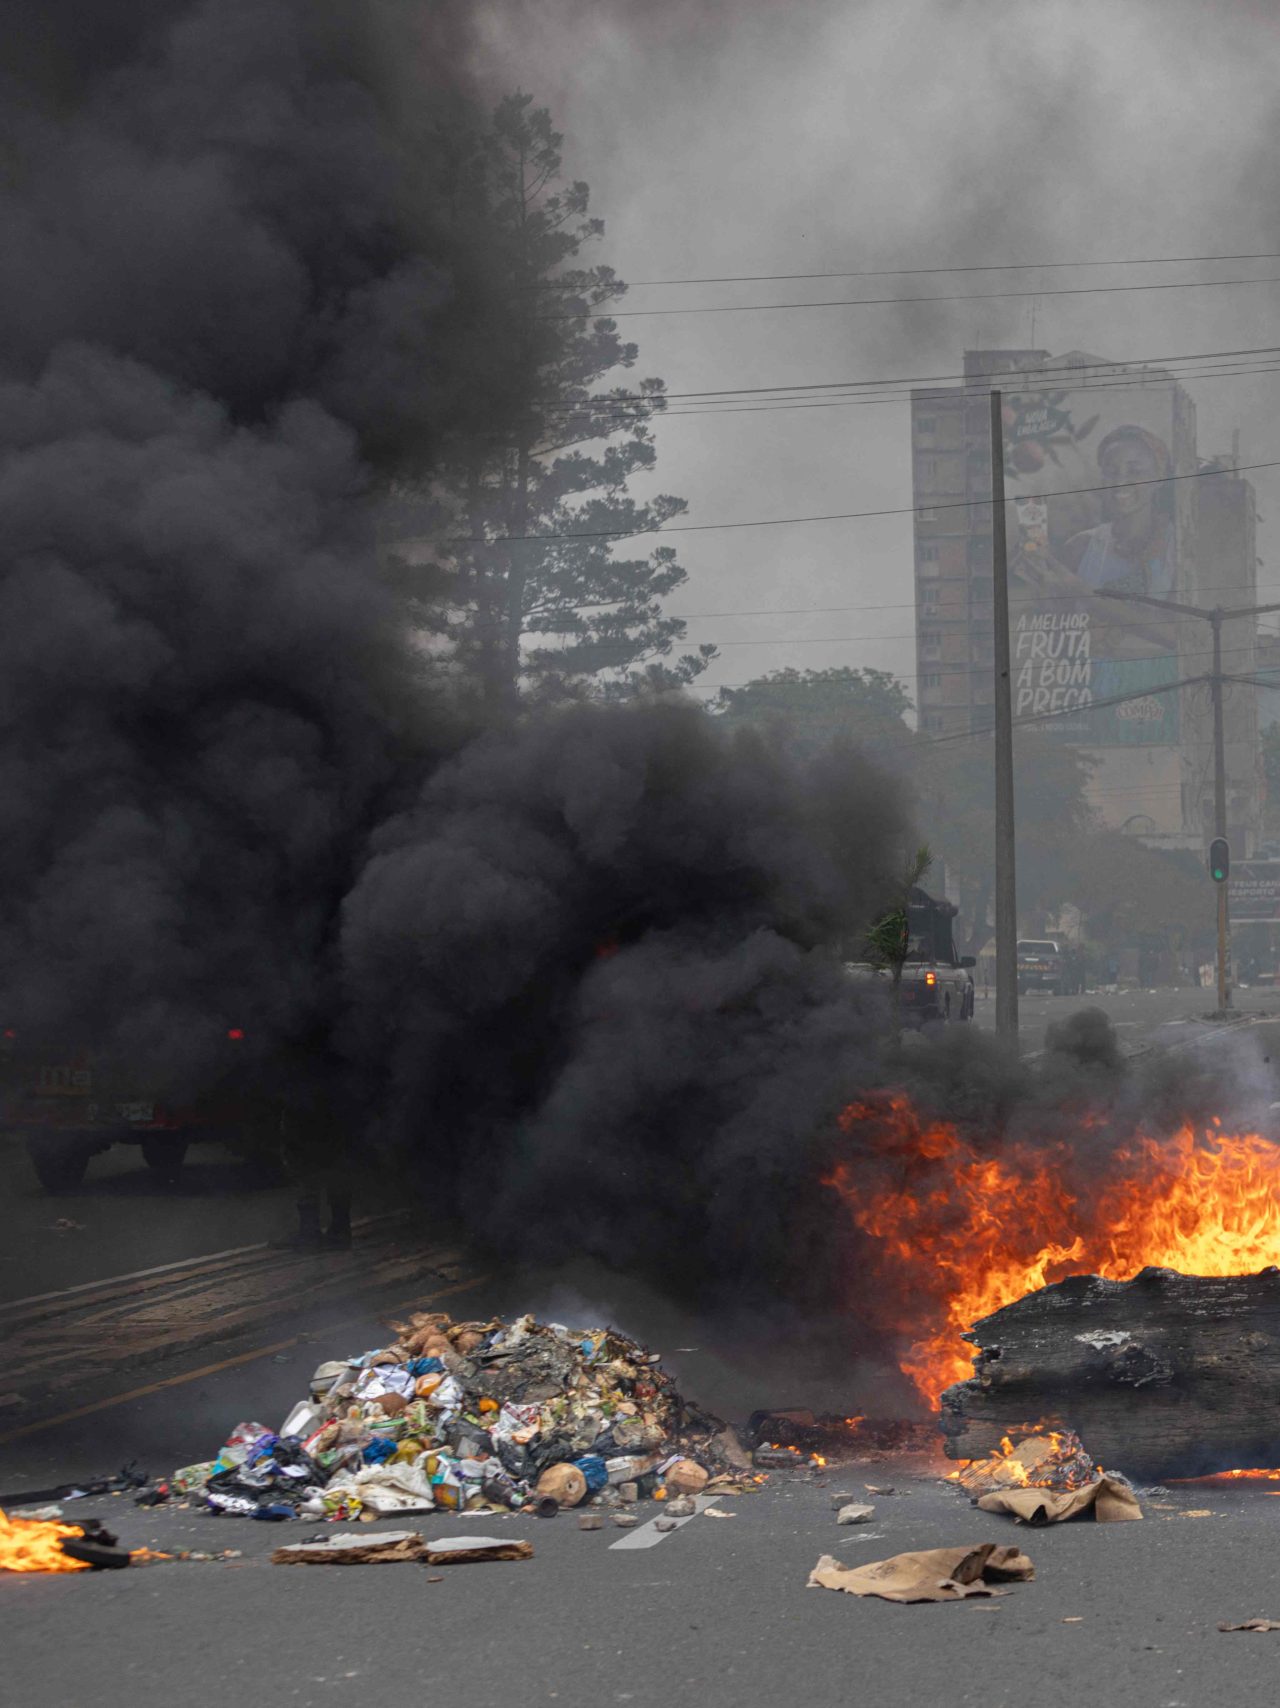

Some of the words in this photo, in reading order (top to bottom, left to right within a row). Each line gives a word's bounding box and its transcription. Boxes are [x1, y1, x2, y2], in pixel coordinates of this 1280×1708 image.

[1016, 615, 1026, 632] A
[1031, 613, 1090, 631] MELHOR
[1016, 629, 1091, 659] FRUTA
[1016, 659, 1033, 688] A
[1040, 658, 1092, 687] BOM
[1016, 686, 1093, 717] PREÇO
